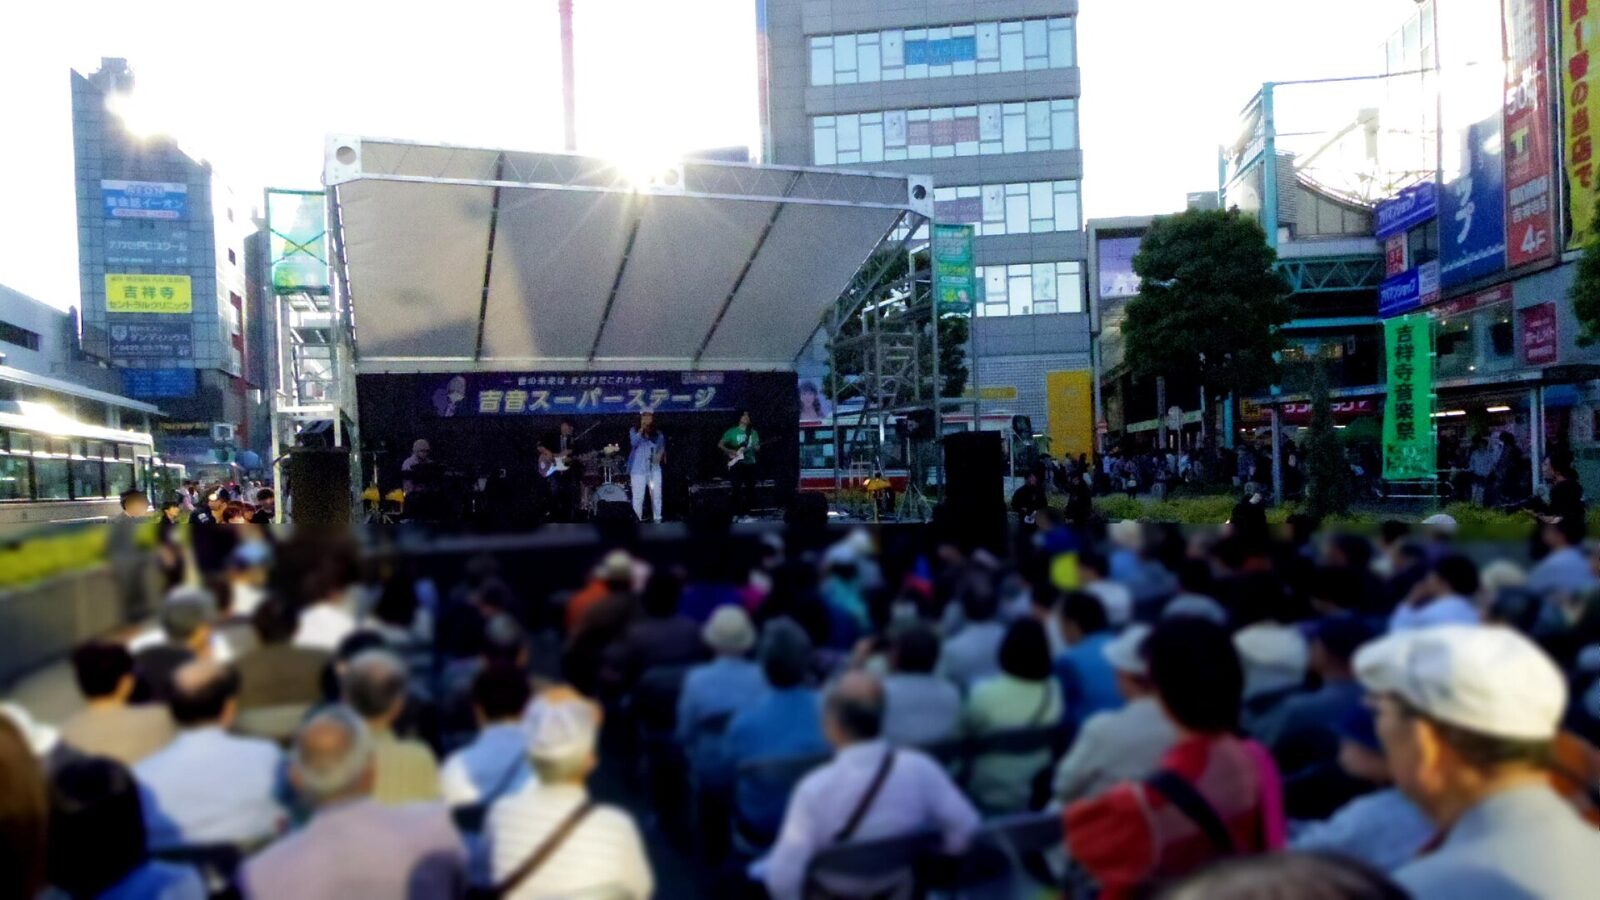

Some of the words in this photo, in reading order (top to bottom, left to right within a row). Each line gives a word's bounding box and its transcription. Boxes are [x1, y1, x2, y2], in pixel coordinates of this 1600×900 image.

[124, 286, 174, 299] 吉祥寺
[109, 301, 189, 310] セントラルクリニック
[478, 386, 716, 413] 吉音スーパーステージ
